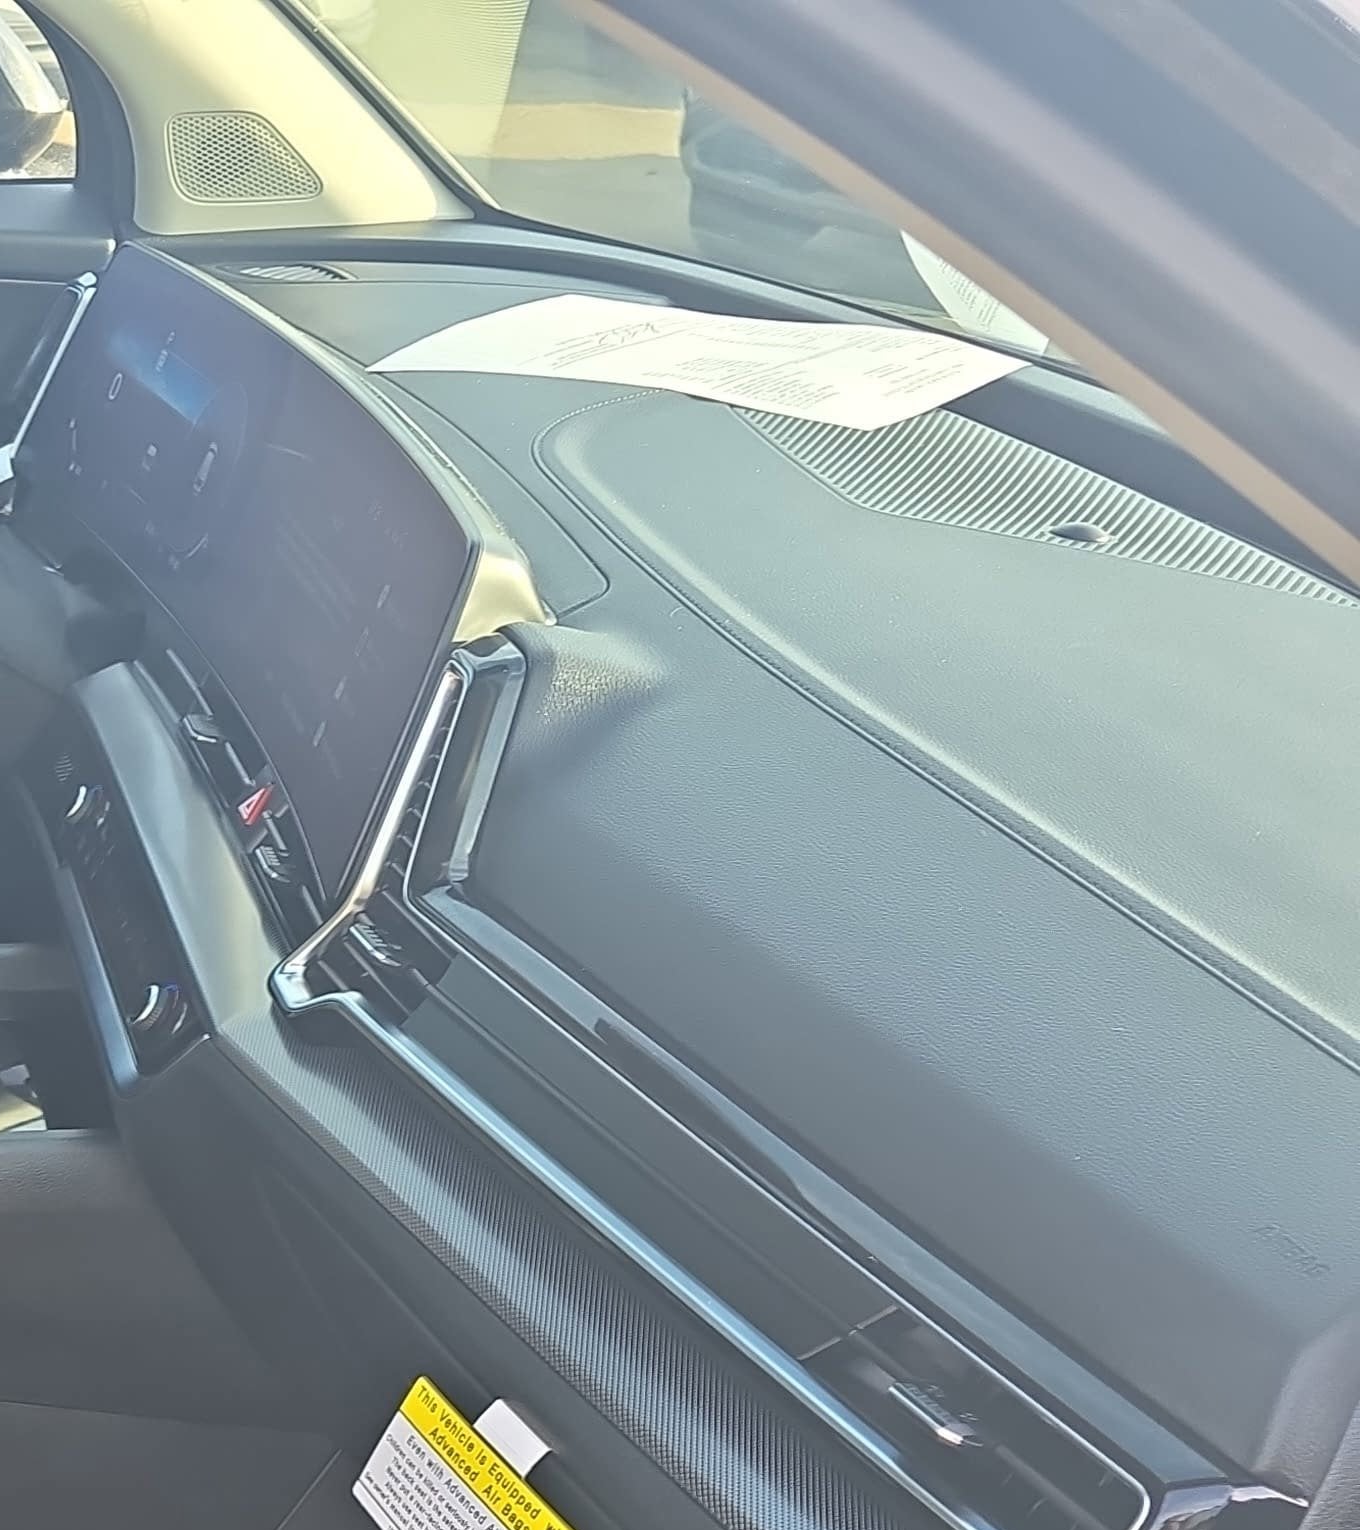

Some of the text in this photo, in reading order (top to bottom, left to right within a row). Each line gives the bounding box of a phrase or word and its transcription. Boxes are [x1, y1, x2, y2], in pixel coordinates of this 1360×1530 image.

[391, 1455, 403, 1471] The
[400, 1467, 415, 1486] back
[414, 1483, 427, 1499] seat
[425, 1496, 433, 1506] is
[432, 1502, 443, 1517] the
[404, 1456, 416, 1471] can
[414, 1467, 424, 1480] be
[422, 1476, 439, 1496] killed
[437, 1493, 445, 1504] or
[405, 1433, 428, 1460] Even
[425, 1456, 445, 1480] with
[443, 1475, 487, 1526] Advanced
[416, 1385, 440, 1414] This
[437, 1408, 477, 1454] Vehicle
[485, 1461, 541, 1523] Equipped
[428, 1425, 480, 1483] Advanced
[482, 1481, 503, 1507] Air
